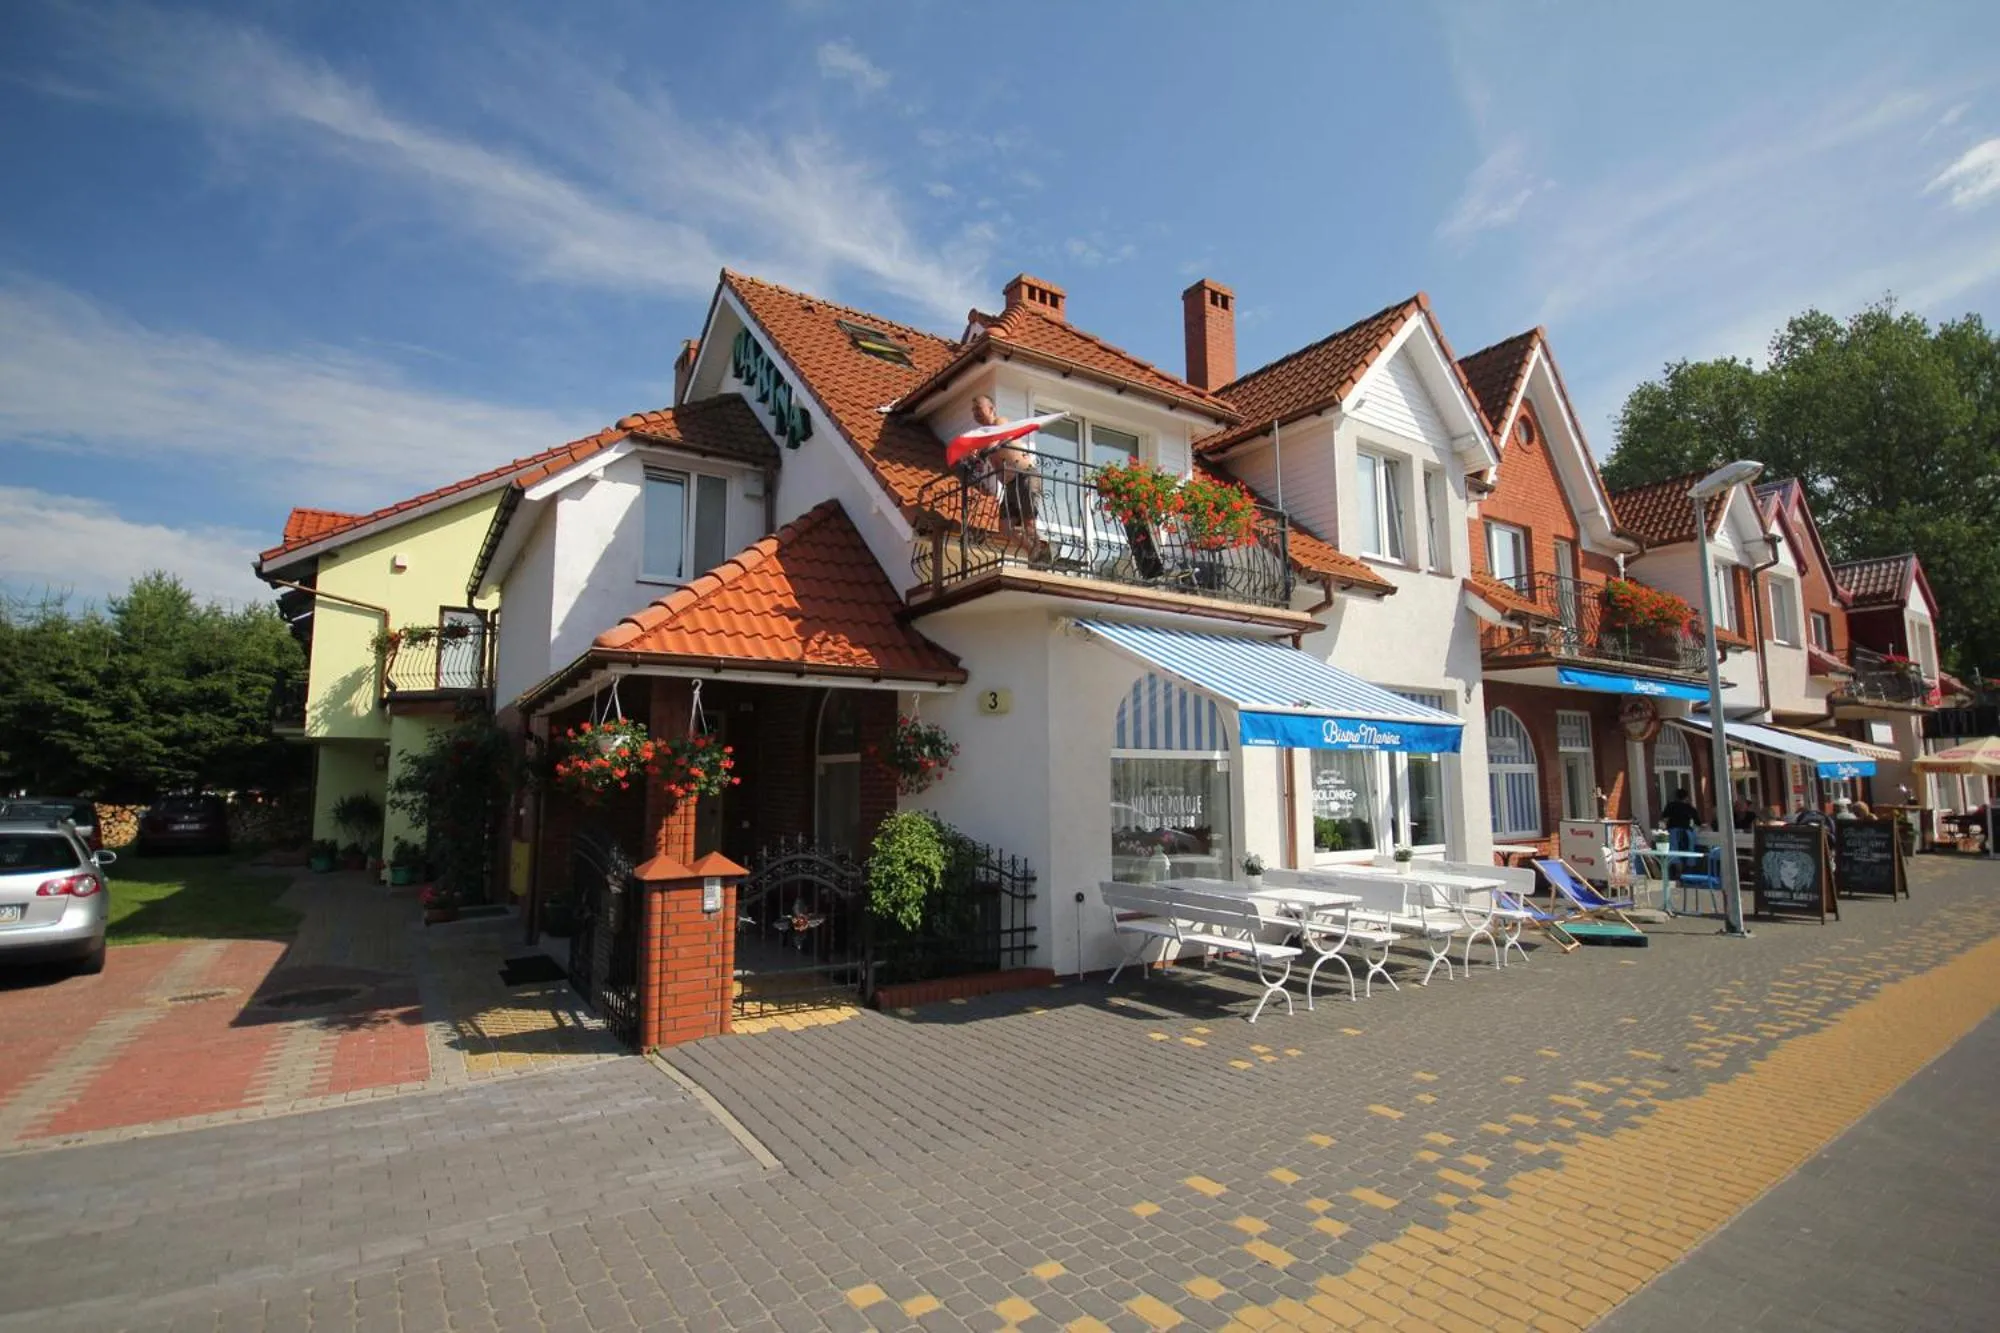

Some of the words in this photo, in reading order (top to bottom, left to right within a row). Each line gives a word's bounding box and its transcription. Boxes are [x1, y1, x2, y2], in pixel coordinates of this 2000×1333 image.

[988, 691, 998, 709] 3
[1323, 719, 1360, 744] Bistro
[1359, 723, 1400, 745] Marina
